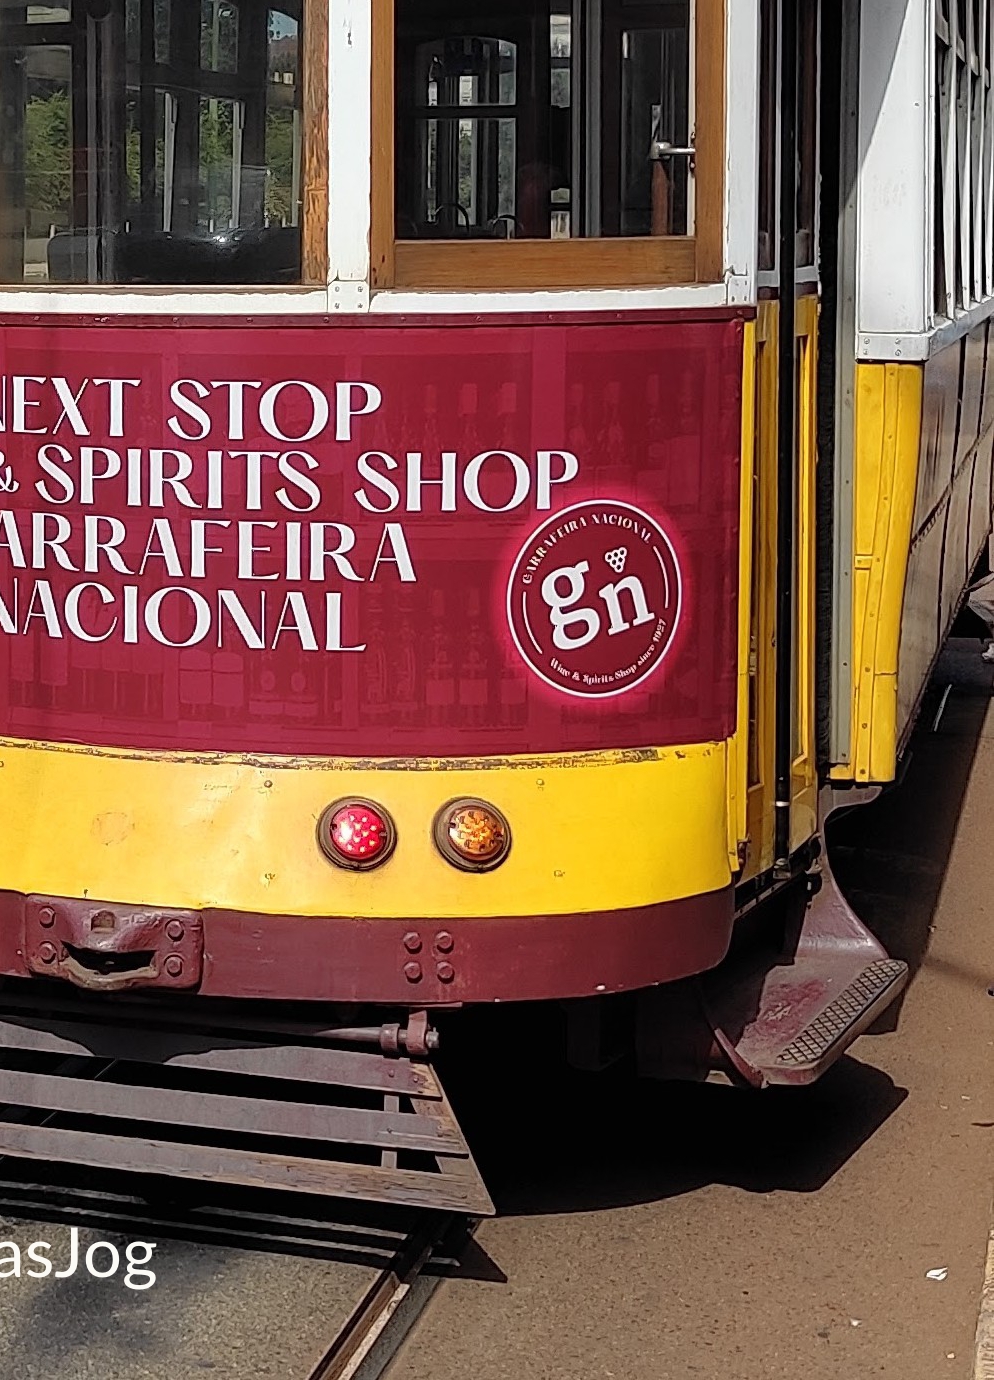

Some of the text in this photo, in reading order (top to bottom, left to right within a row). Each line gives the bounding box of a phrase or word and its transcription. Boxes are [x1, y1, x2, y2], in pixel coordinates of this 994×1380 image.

[167, 379, 382, 442] STOP
[35, 444, 322, 513] SPIRITS
[353, 449, 579, 513] SHOP
[522, 513, 652, 584] GARRAFEIRA NACIONAL
[541, 560, 656, 650] gn
